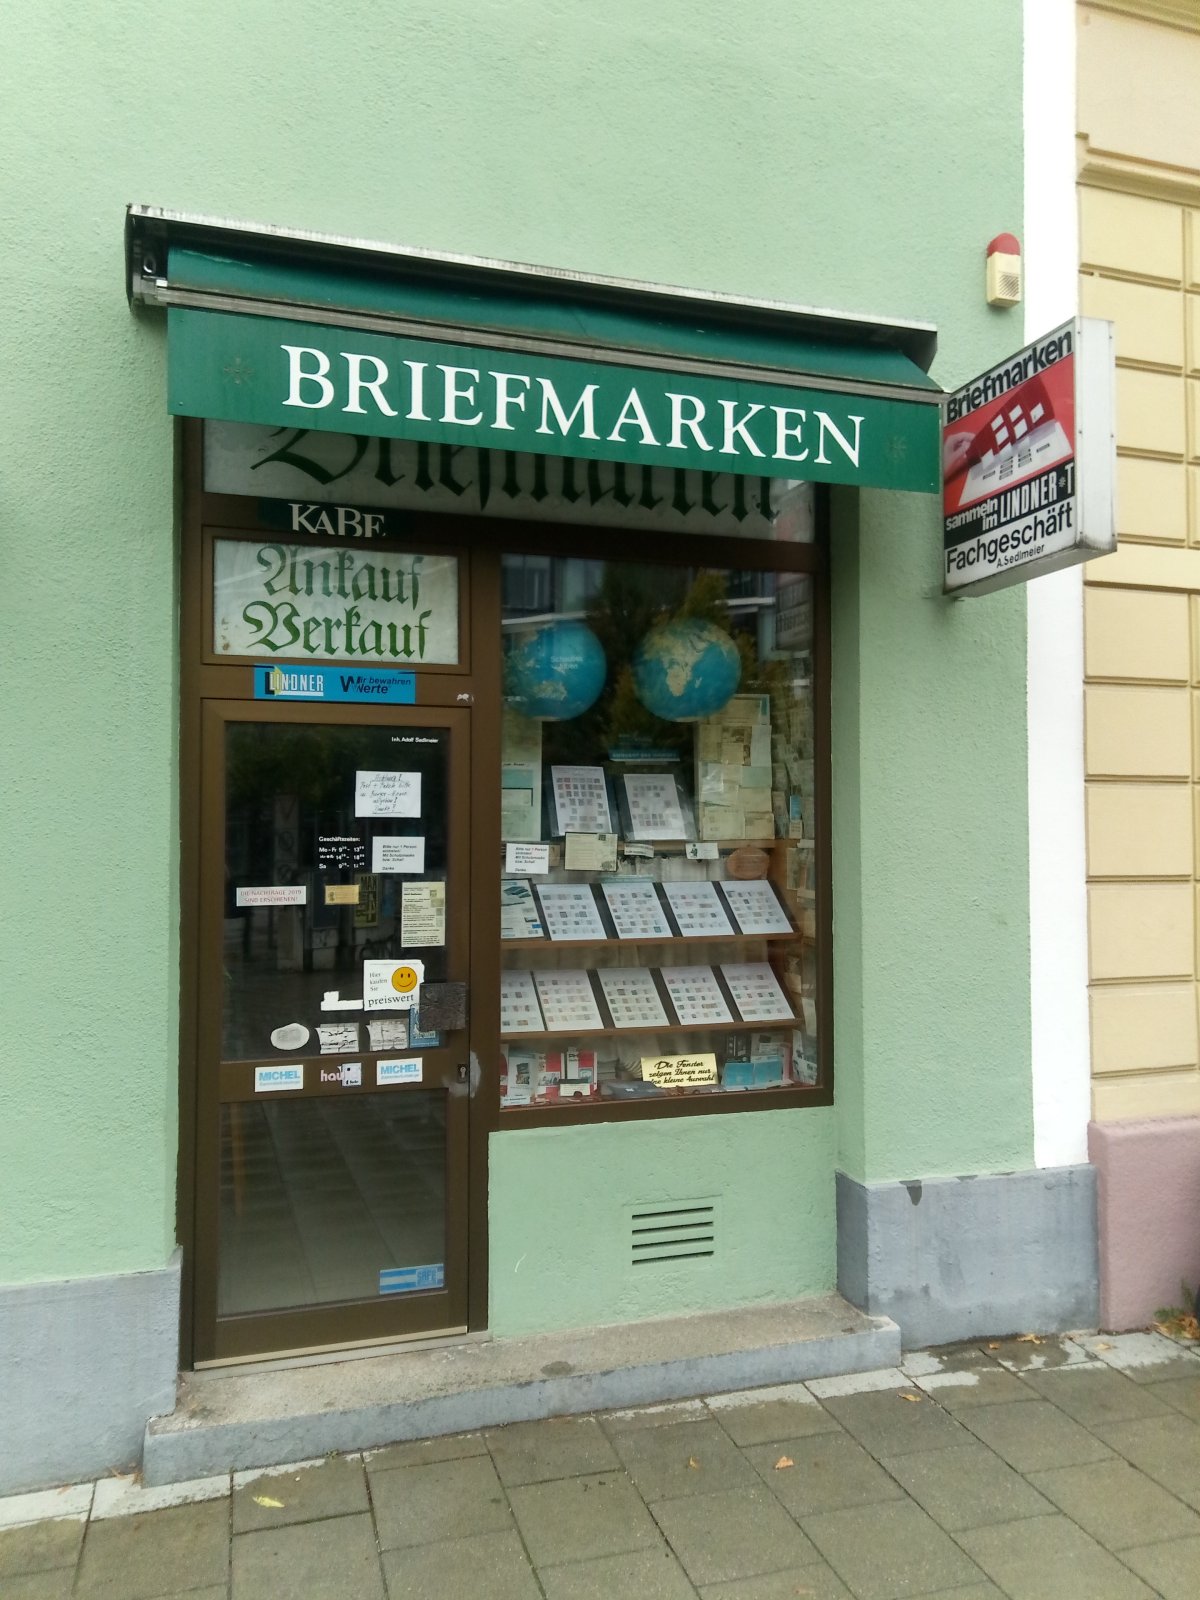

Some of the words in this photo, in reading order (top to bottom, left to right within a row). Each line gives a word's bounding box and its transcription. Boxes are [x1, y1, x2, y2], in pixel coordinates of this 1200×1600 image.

[946, 330, 1073, 424] Briefmarken
[279, 343, 866, 468] BRIEFMARKEN
[1001, 470, 1058, 523] LINDNER
[287, 503, 387, 538] KABE
[946, 497, 998, 531] sammeln
[982, 513, 998, 531] im
[946, 501, 1073, 573] Fachgeschäft
[256, 543, 425, 611] Ankauf
[242, 600, 433, 660] Verkauf
[264, 671, 324, 696] LINDNER
[369, 676, 412, 686] bewahren
[368, 994, 415, 1008] preiswert
[258, 1070, 301, 1082] MICHEL
[380, 1063, 420, 1075] MICHEL
[649, 1070, 672, 1079] zeigen
[675, 1068, 696, 1076] Ihnen
[654, 1060, 673, 1070] Die
[676, 1059, 704, 1068] Fenster
[663, 1076, 684, 1084] kleine
